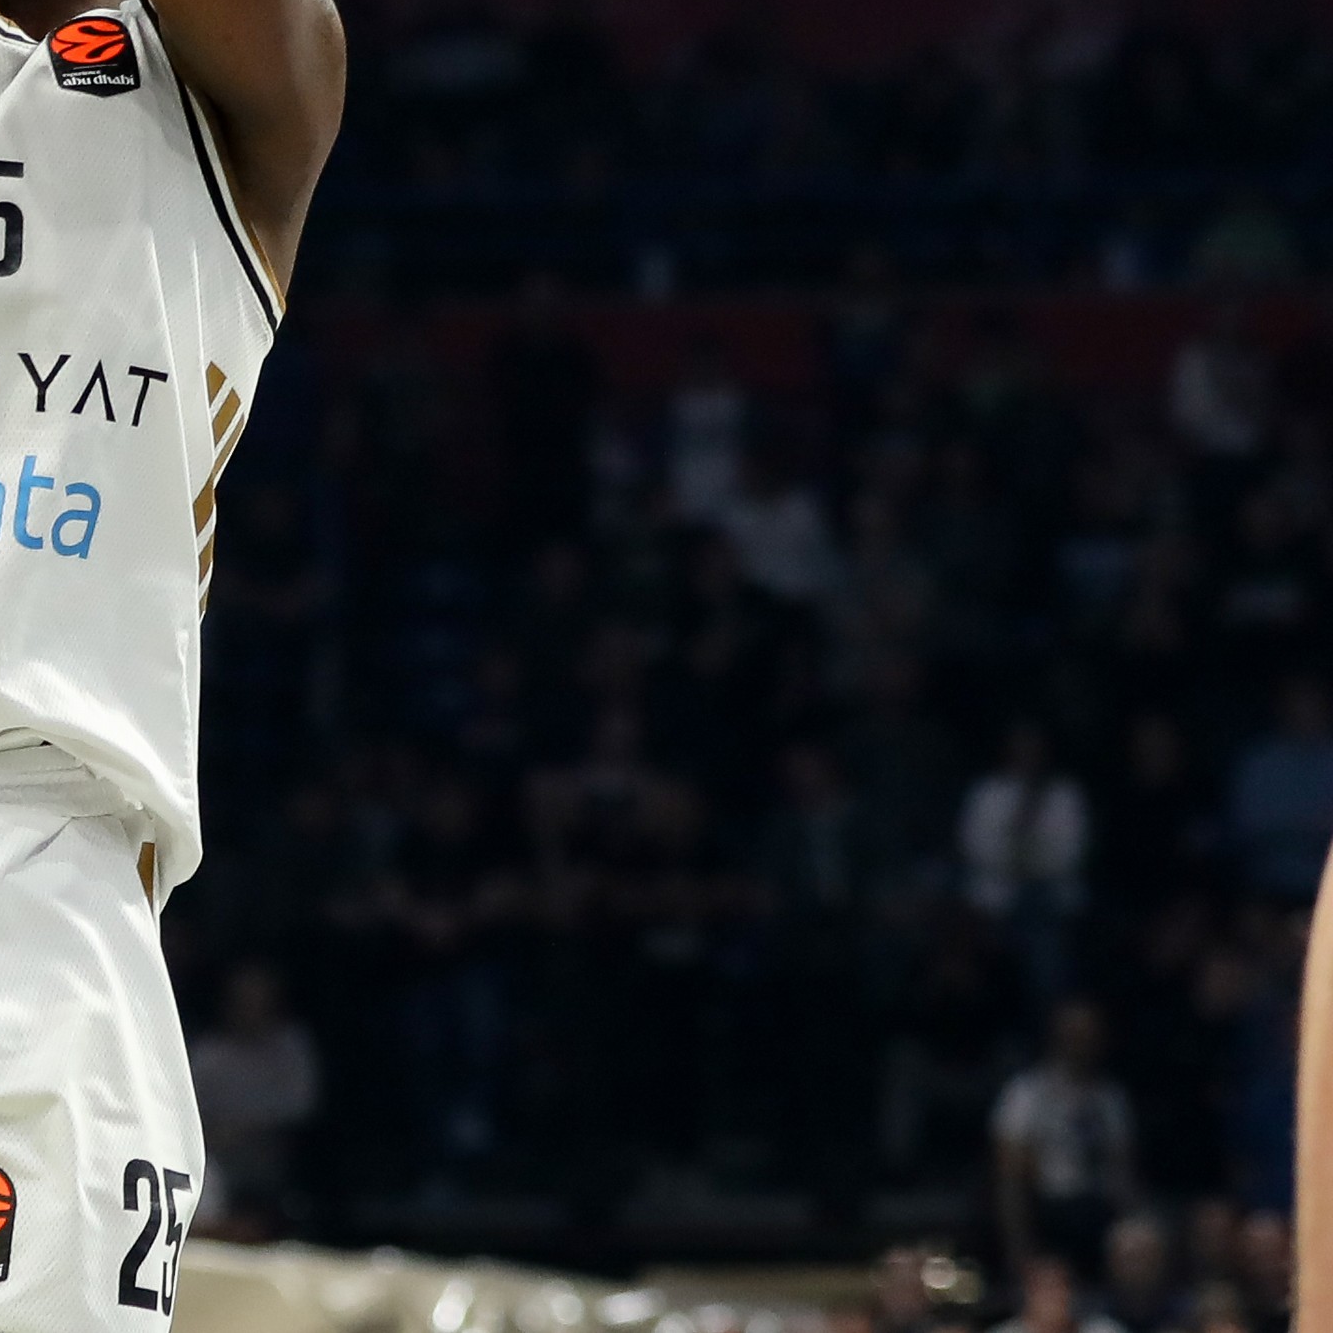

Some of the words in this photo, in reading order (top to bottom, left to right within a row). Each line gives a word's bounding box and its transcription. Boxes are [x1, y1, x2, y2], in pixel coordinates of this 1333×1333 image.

[62, 76, 91, 86] abu
[93, 74, 135, 86] dhabi
[118, 1158, 193, 1317] 25
